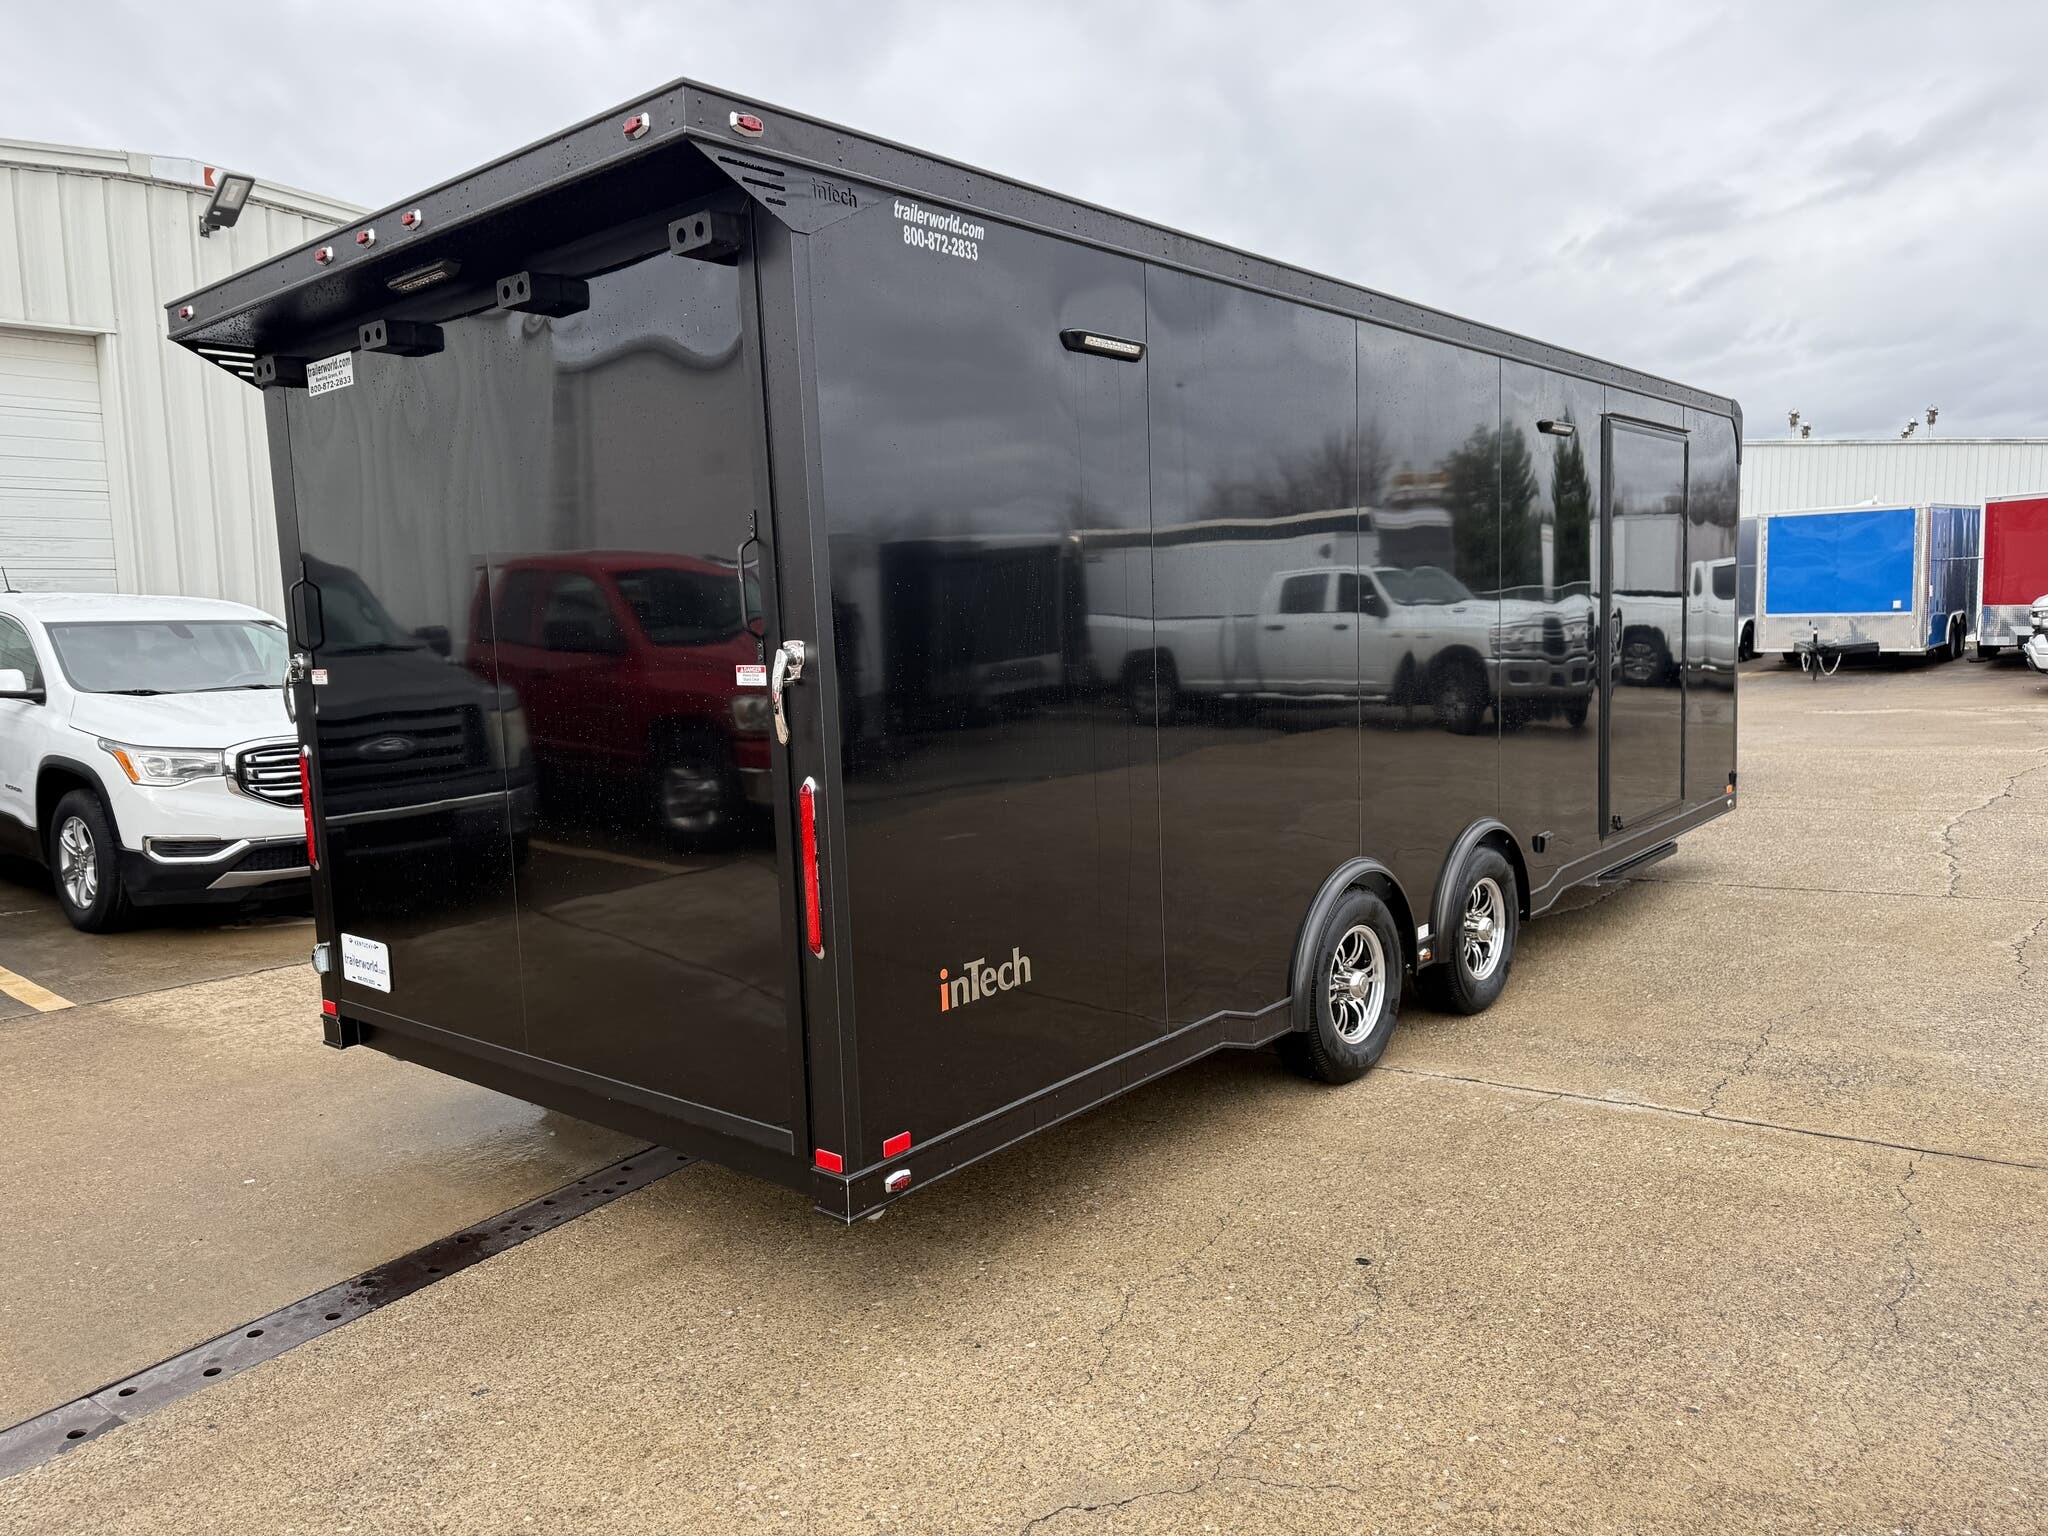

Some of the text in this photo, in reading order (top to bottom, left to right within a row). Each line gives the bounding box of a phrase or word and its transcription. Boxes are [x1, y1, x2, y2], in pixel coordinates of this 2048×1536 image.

[811, 177, 858, 208] inTech
[893, 199, 985, 241] trailerworld.com
[903, 224, 979, 262] 800-872-2833
[306, 356, 352, 378] trailerworld.com
[310, 375, 352, 394] 800-872-2833
[940, 946, 1032, 1012] inTech
